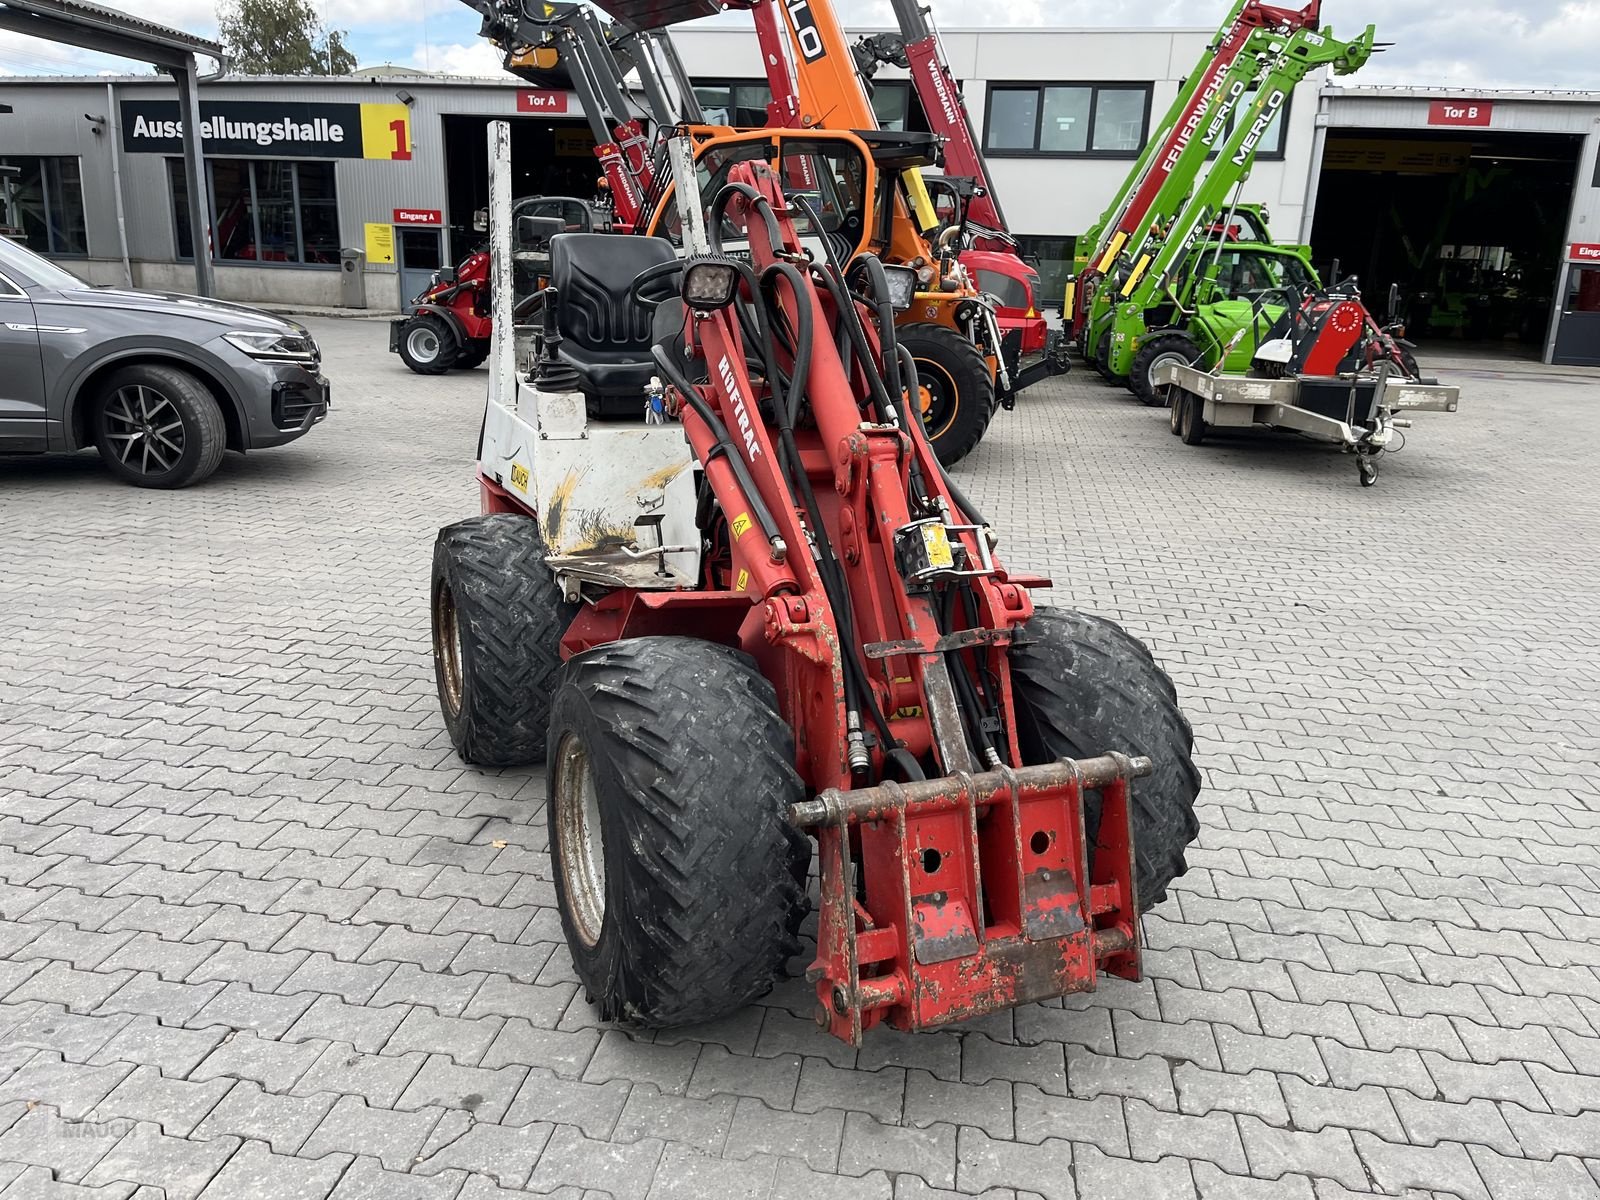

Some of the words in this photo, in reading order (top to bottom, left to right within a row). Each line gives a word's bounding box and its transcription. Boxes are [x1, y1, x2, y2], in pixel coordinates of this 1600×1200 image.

[786, 0, 822, 58] LO
[527, 95, 545, 106] Tor
[547, 95, 557, 106] A
[928, 58, 956, 124] WEIDEMANN
[1444, 106, 1465, 118] Tor
[1467, 107, 1478, 118] B
[133, 115, 344, 145] Aussellungshalle
[1201, 81, 1245, 146] MERLO
[1232, 90, 1285, 166] MERLO
[389, 119, 412, 161] 1
[616, 165, 638, 209] WEIDEMANN
[400, 212, 428, 221] Eingang
[1185, 225, 1203, 250] 27.6
